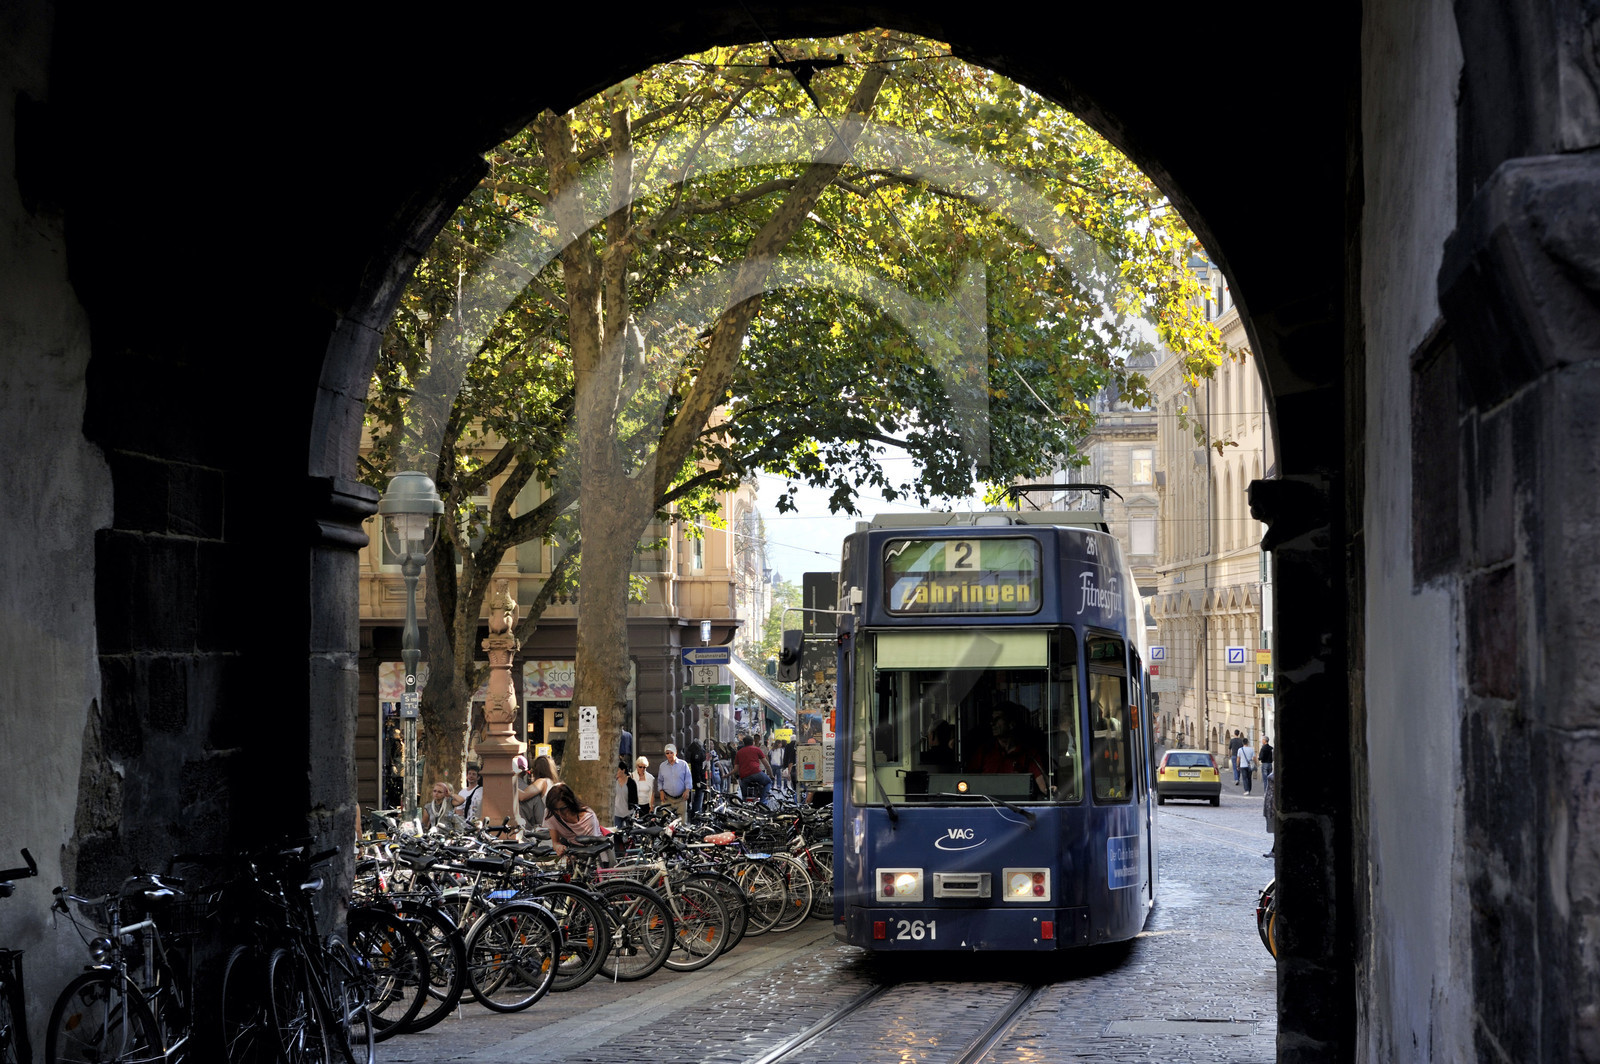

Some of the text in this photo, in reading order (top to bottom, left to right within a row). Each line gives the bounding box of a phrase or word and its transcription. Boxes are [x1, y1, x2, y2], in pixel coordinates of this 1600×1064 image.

[954, 541, 973, 569] 2
[1085, 536, 1098, 556] 261
[947, 828, 975, 840] VAG
[896, 920, 937, 940] 261
